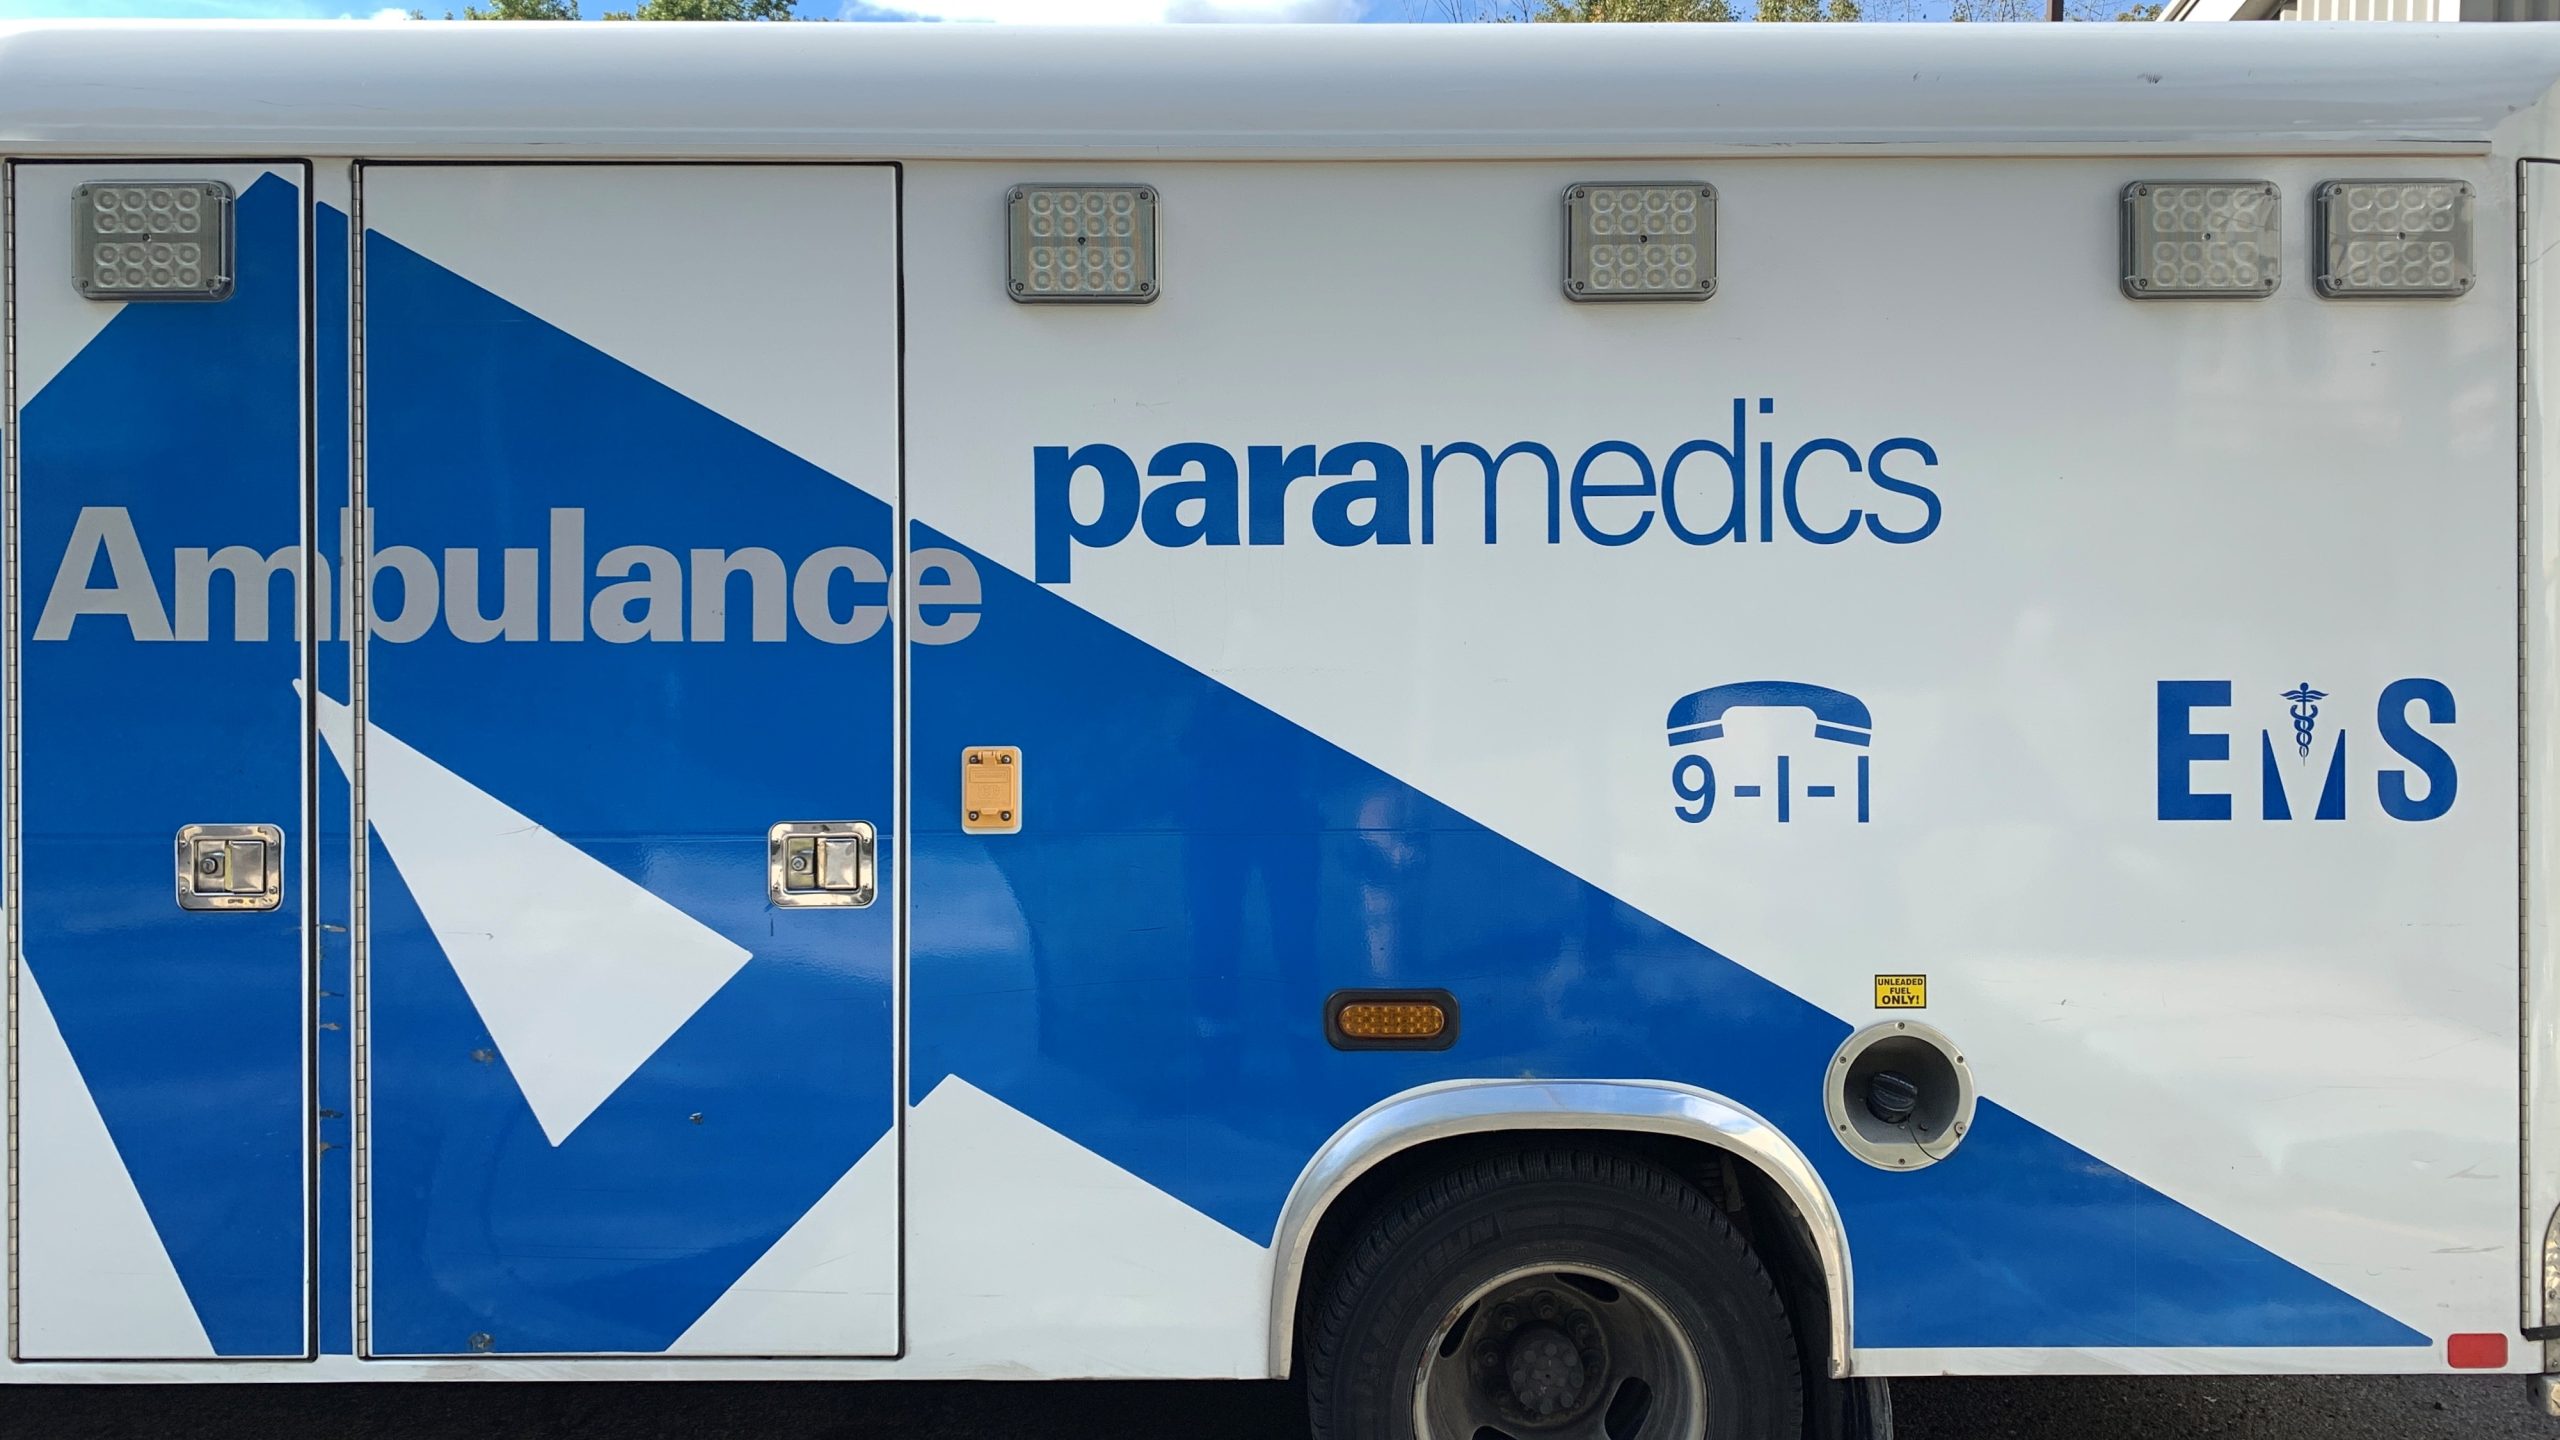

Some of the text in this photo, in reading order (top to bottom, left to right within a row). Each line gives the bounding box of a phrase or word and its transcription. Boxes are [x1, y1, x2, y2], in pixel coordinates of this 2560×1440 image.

[1034, 398, 1942, 582] paramedics
[33, 506, 983, 645] Ambulance
[2157, 678, 2457, 822] EMS
[1877, 978, 1923, 986] UNLEADED
[1882, 995, 1920, 1005] ONLY!
